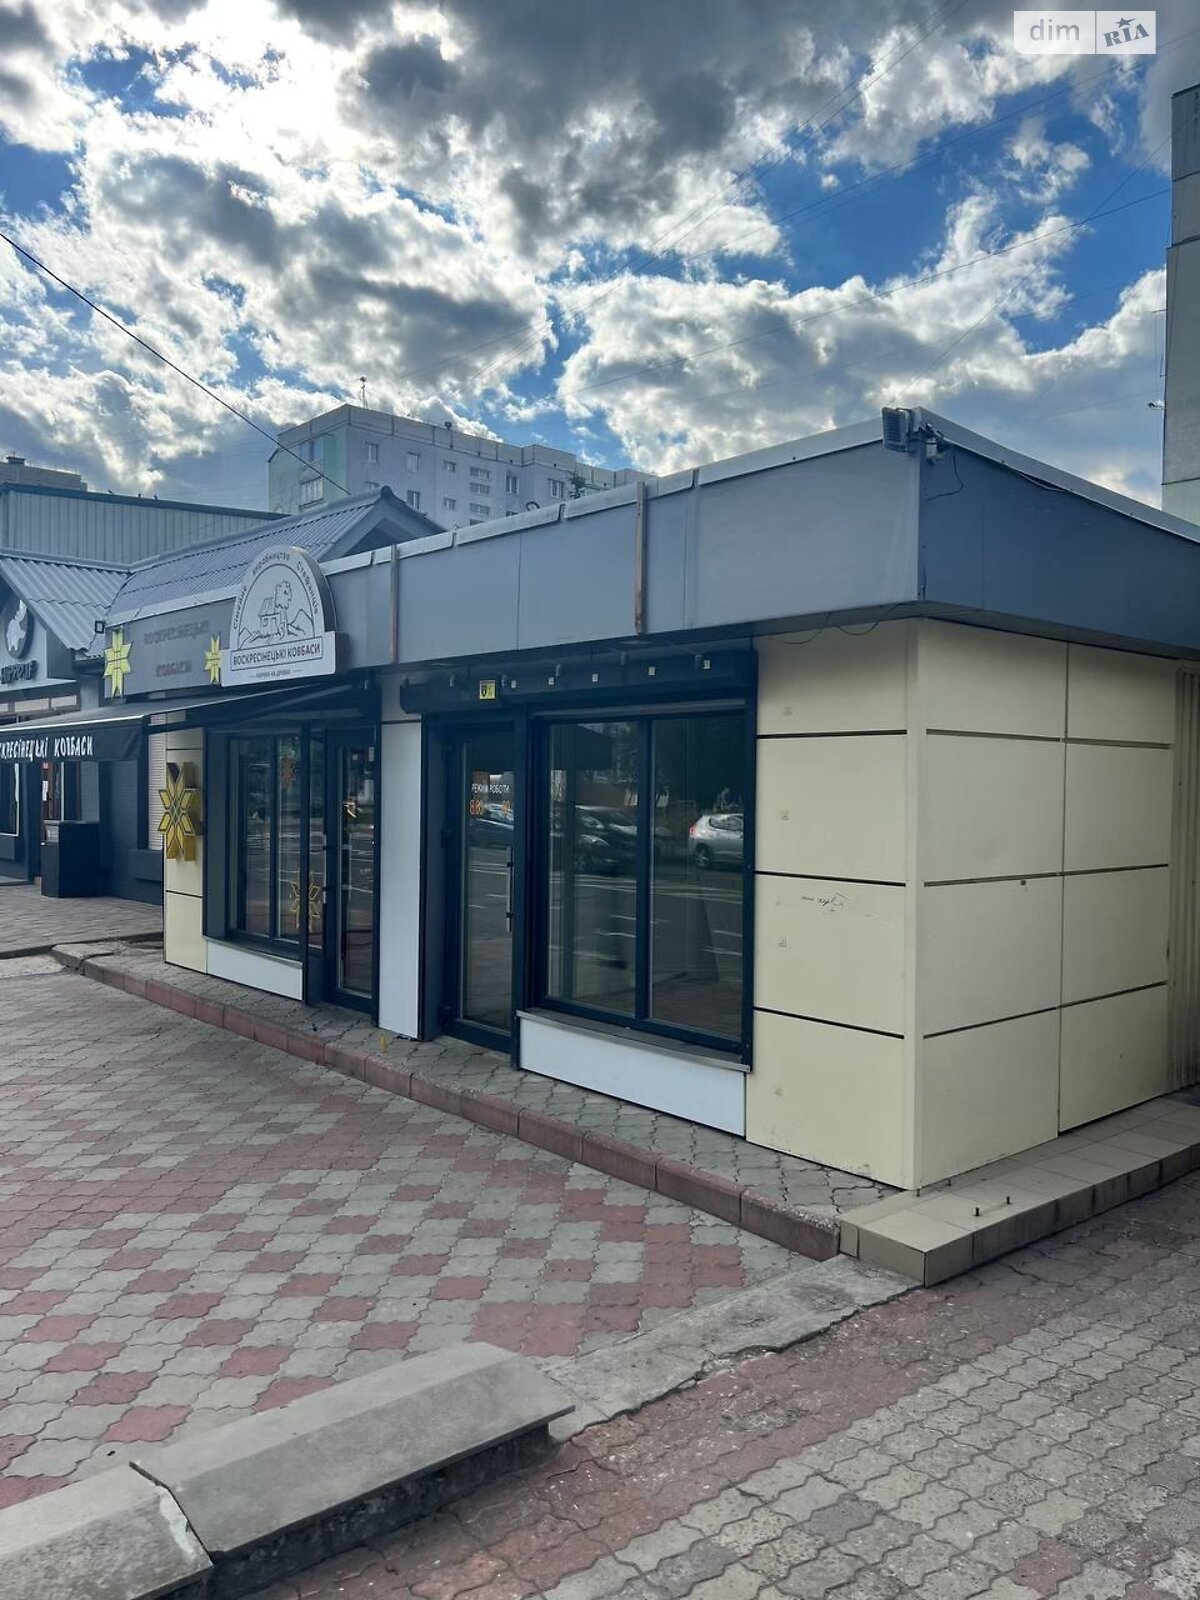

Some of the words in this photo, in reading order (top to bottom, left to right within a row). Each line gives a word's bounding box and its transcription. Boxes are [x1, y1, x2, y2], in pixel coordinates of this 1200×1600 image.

[233, 648, 287, 666] ВОСКРЕСІНЕЦЬКІ
[287, 643, 320, 659] КОВБАСИ
[54, 736, 94, 757] КОВБАСИ
[490, 784, 511, 794] РОБОТИ
